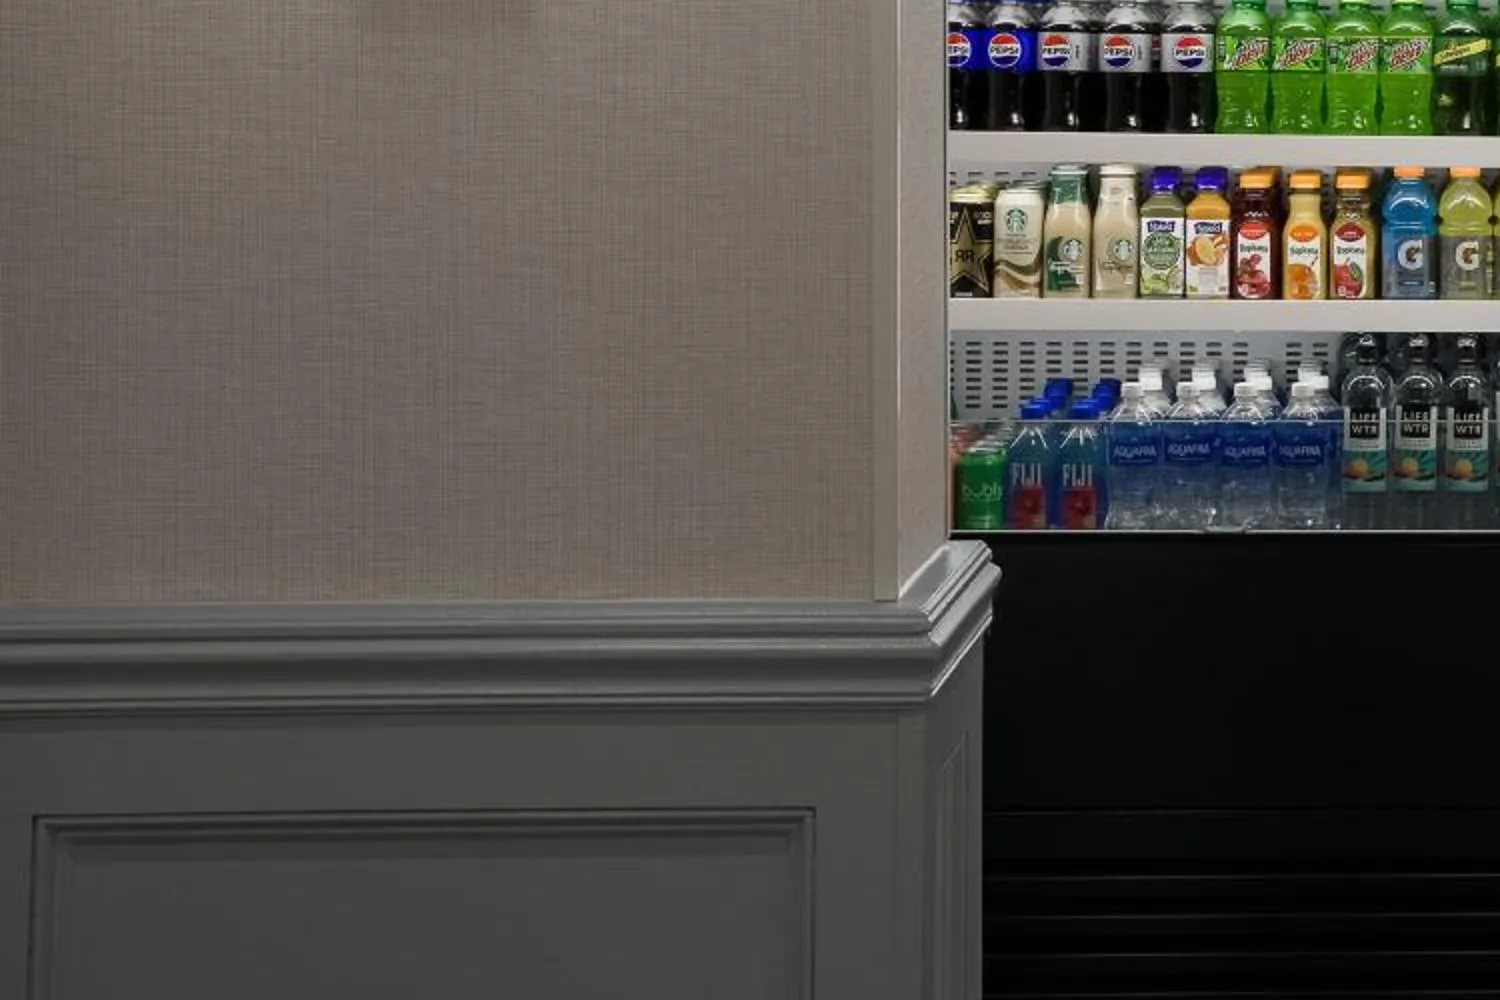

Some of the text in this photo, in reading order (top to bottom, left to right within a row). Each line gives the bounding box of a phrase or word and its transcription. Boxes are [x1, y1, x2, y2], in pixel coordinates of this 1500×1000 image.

[1397, 239, 1423, 270] G
[1455, 241, 1480, 271] G
[1352, 424, 1377, 434] WTR
[1403, 424, 1429, 434] WTR
[1456, 424, 1480, 434] WTR
[1012, 463, 1042, 487] FIJI
[1062, 463, 1092, 487] FIJI
